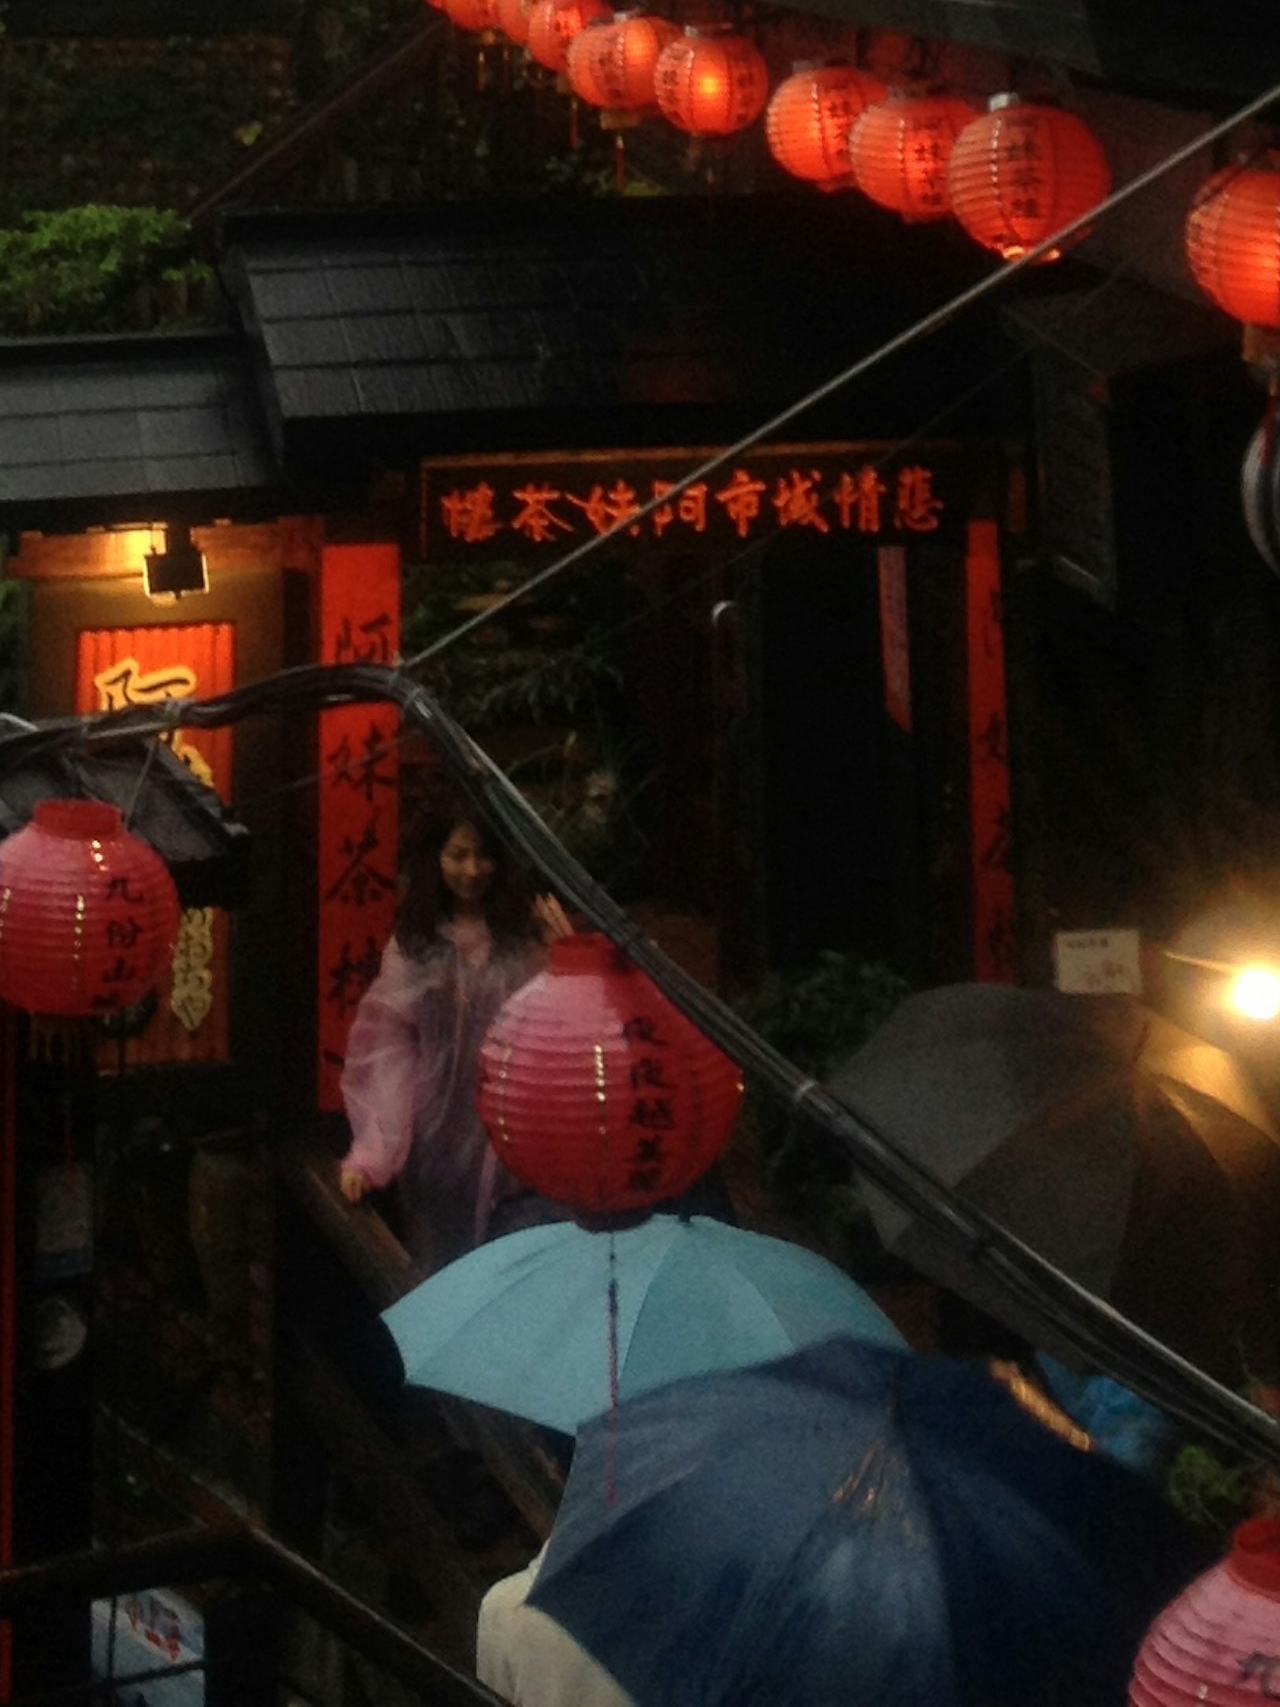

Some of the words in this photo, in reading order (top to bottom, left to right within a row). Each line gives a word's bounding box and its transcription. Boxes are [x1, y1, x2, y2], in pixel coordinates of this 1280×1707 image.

[441, 465, 943, 542] 悲情城市阿妹茶樓
